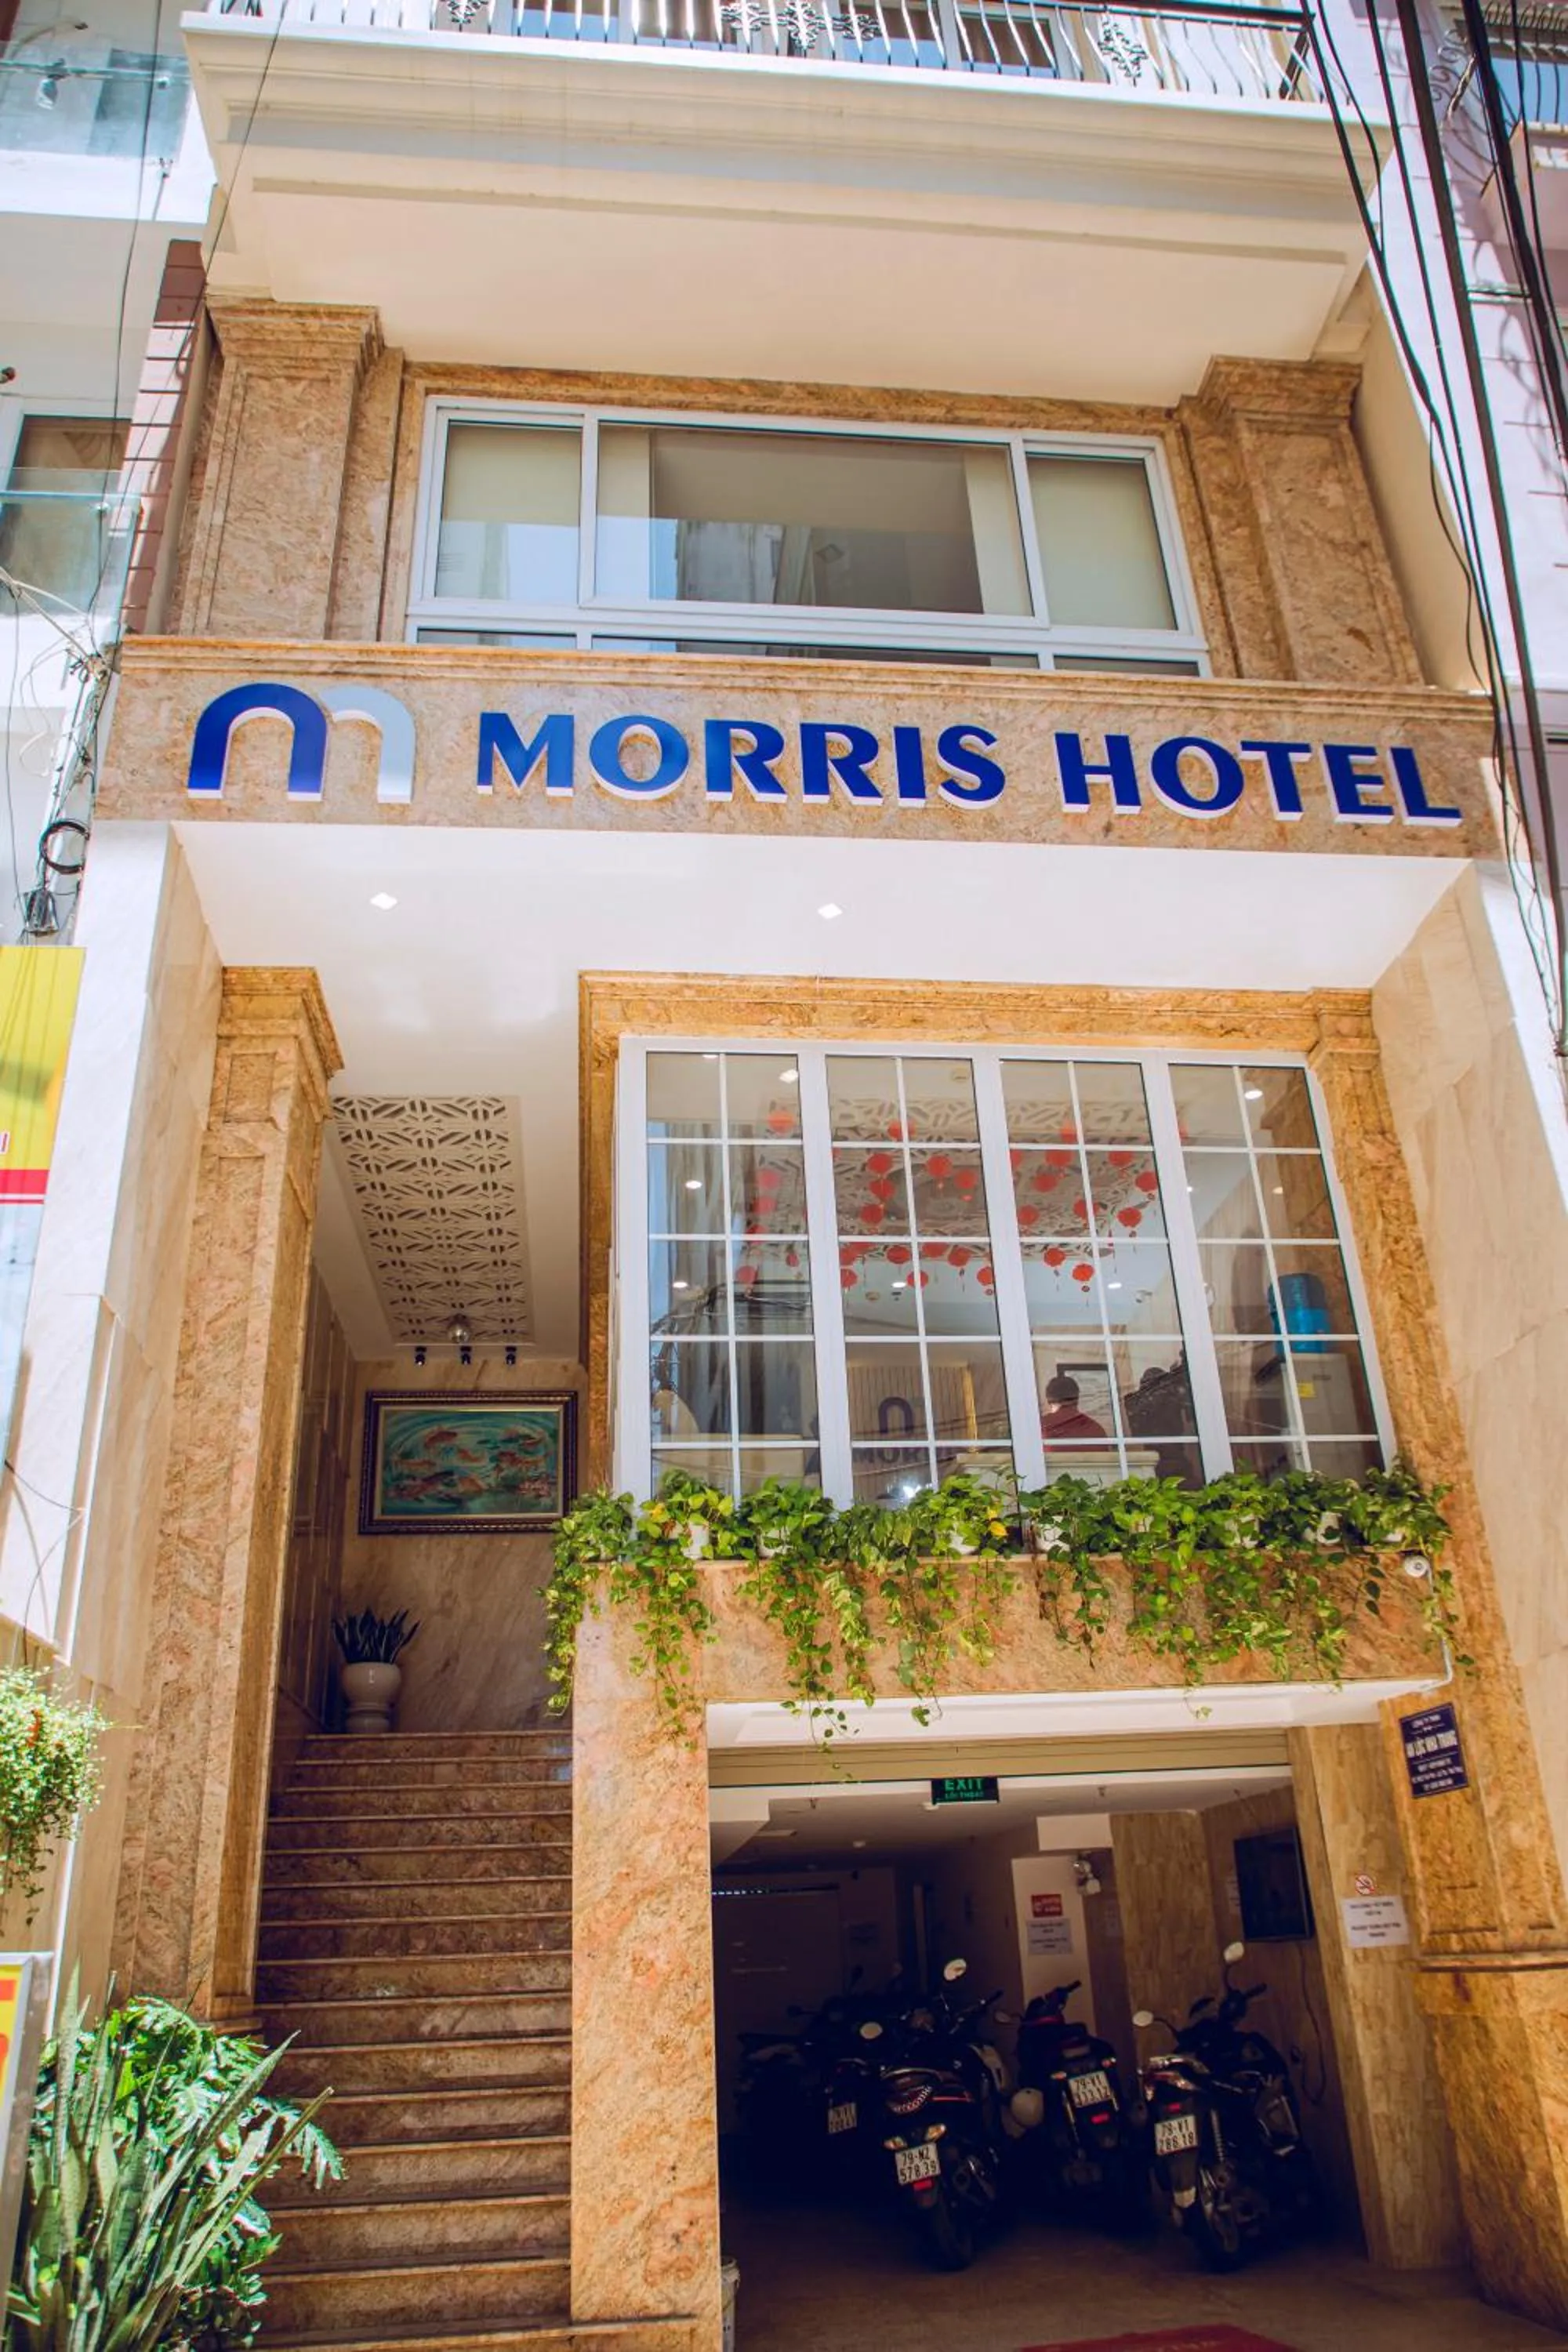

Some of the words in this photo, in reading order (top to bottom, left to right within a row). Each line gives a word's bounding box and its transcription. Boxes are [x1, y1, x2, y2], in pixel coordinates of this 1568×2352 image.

[476, 710, 1007, 811] MORRIS
[1054, 731, 1463, 828] HOTEL
[946, 1778, 982, 1791] EXIT
